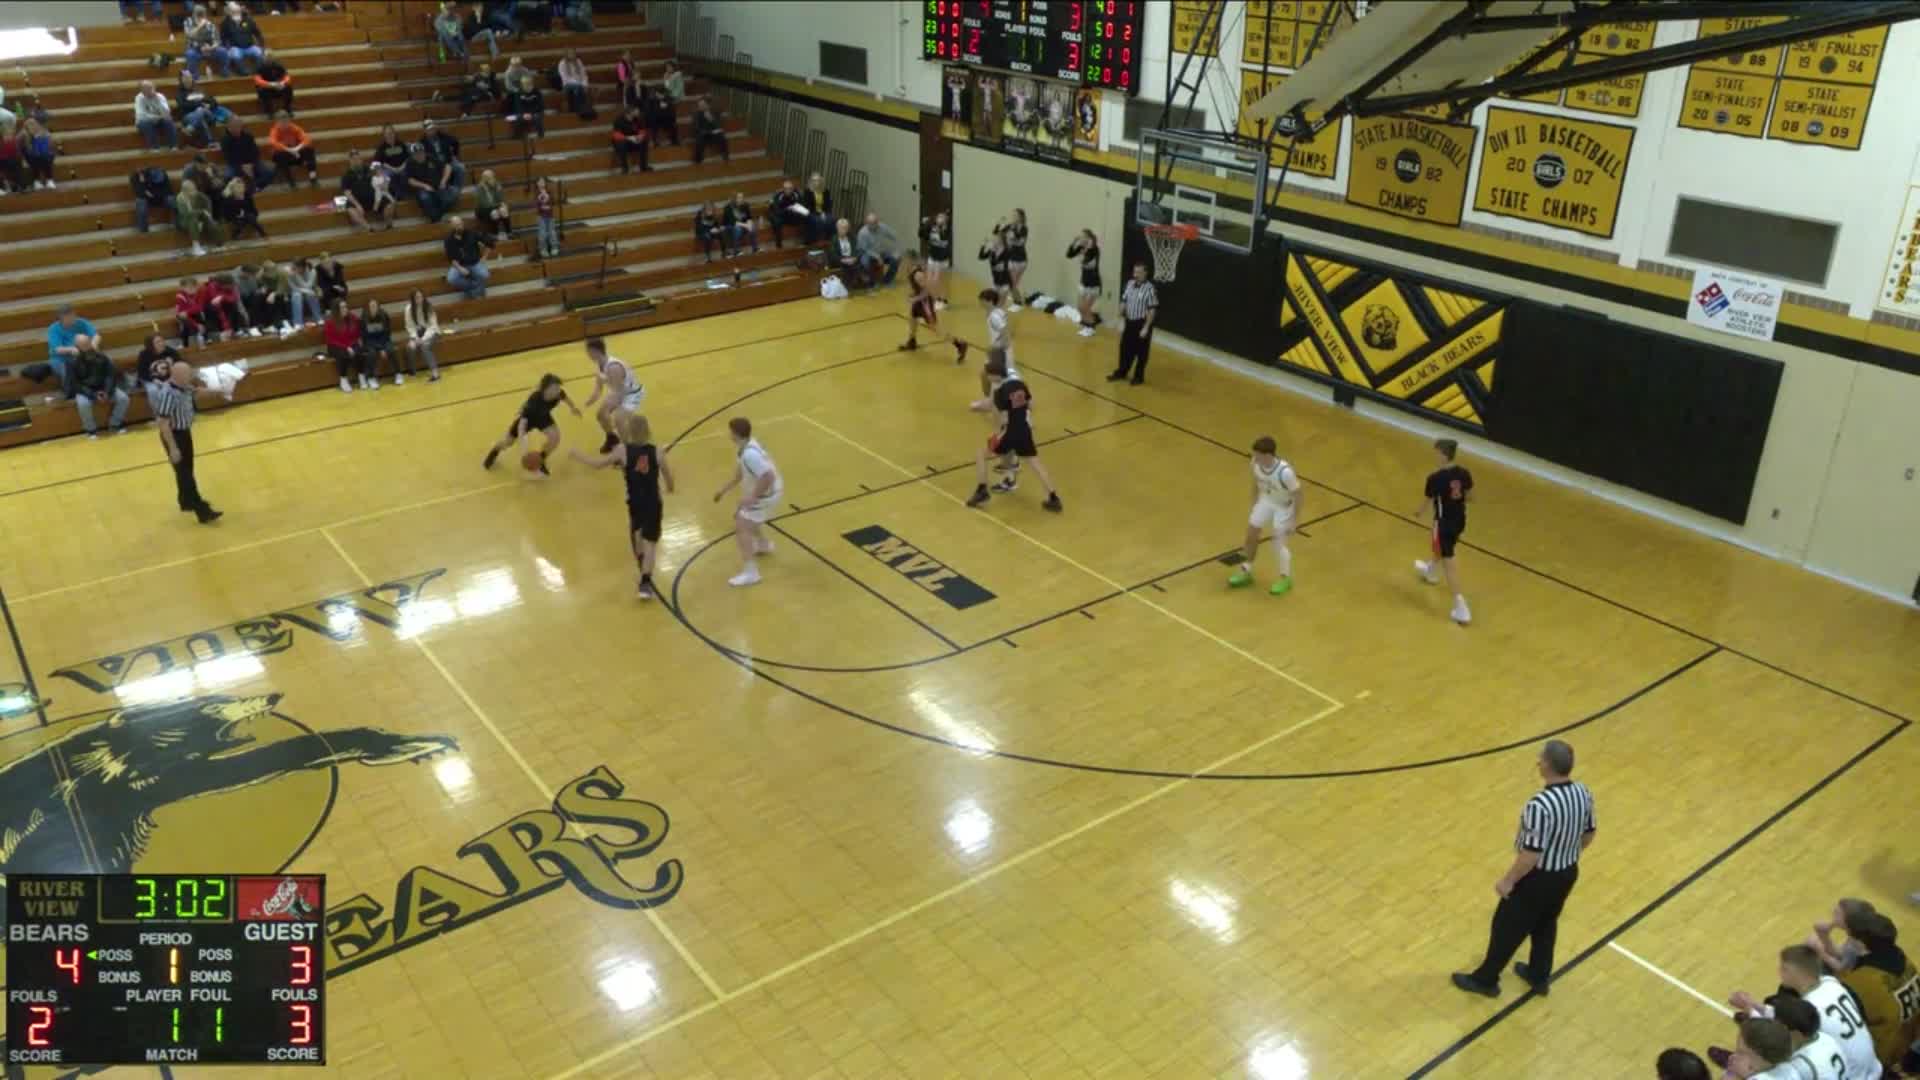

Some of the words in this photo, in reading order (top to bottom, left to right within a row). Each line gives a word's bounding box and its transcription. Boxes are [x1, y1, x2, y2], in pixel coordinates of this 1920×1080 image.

[1715, 76, 1745, 90] STATE
[1807, 87, 1841, 101] STATE
[1355, 126, 1386, 150] STATE
[1405, 119, 1467, 170] BASKETBALL
[1488, 130, 1510, 154] DIV
[1538, 124, 1622, 179] BASKETBALL
[1506, 157, 1526, 172] 20
[1573, 169, 1594, 185] 07
[1378, 189, 1428, 215] CHAMPS
[1490, 187, 1530, 212] STATE
[1542, 197, 1598, 226] CHAMPS
[1293, 282, 1324, 330] RIVER
[1322, 331, 1348, 365] VIEW
[1401, 363, 1440, 391] BLACK
[1442, 330, 1486, 363] BEARS
[1825, 993, 1863, 1039] 30
